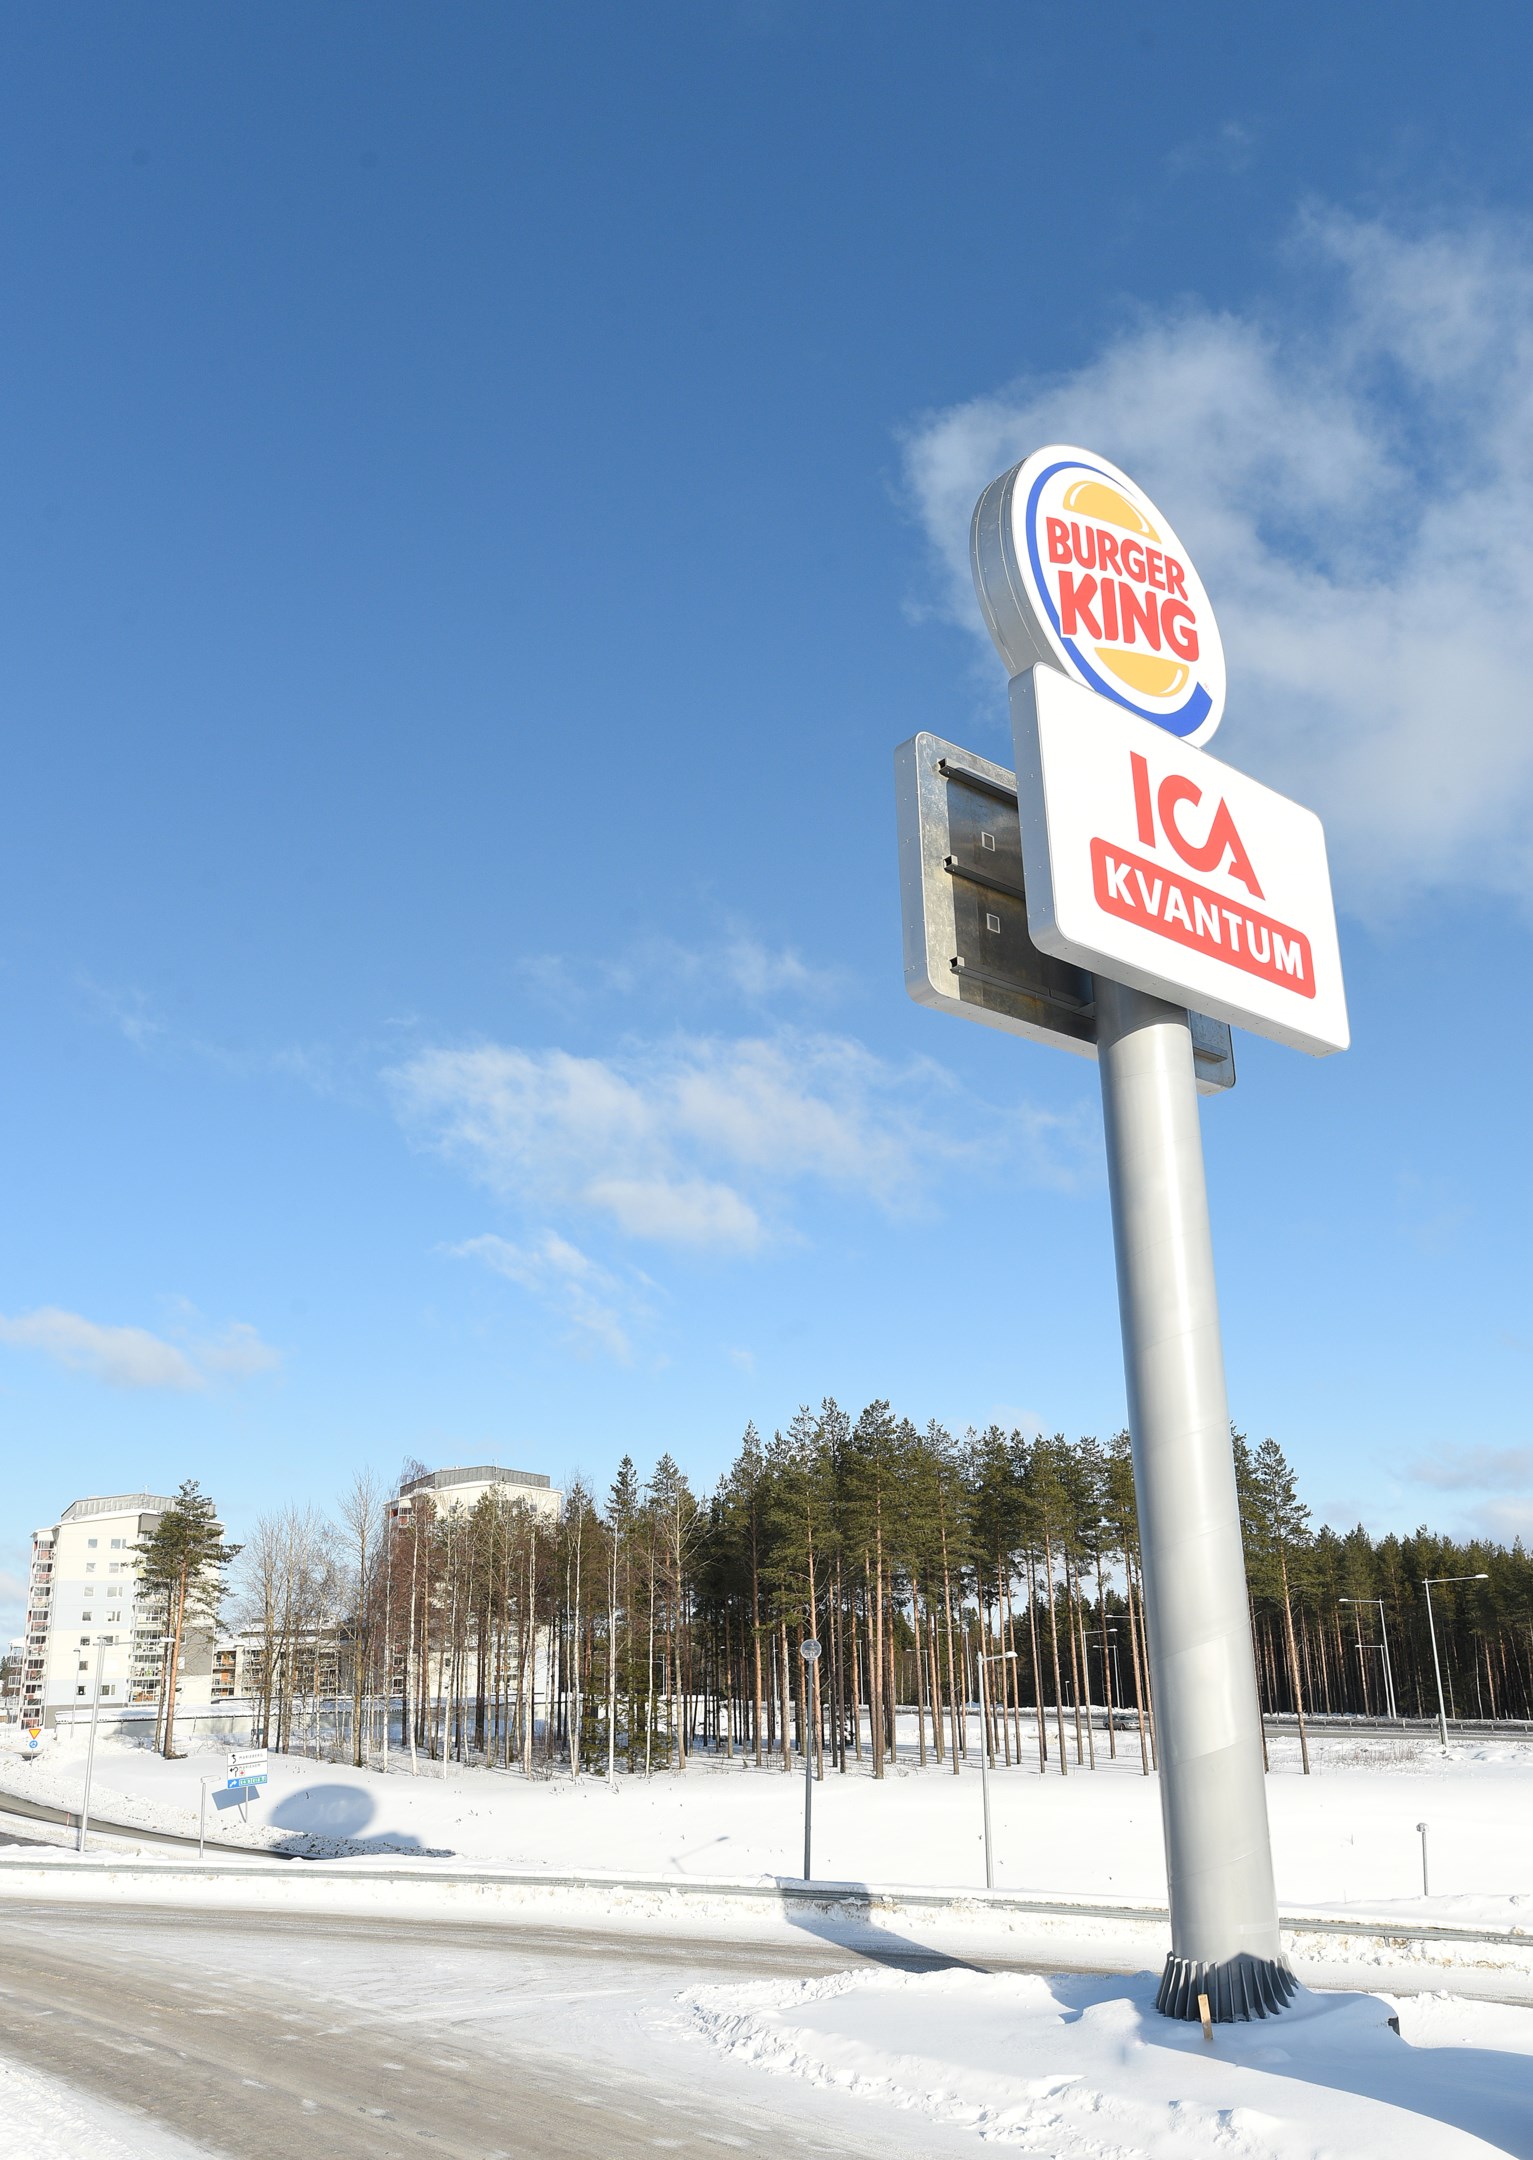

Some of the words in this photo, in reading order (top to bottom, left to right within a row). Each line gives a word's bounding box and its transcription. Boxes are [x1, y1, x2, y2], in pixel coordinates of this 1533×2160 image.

[1046, 517, 1188, 600] BURGER
[1058, 570, 1199, 661] KING
[1130, 752, 1264, 899] ICA
[1106, 856, 1303, 979] KVANTUM
